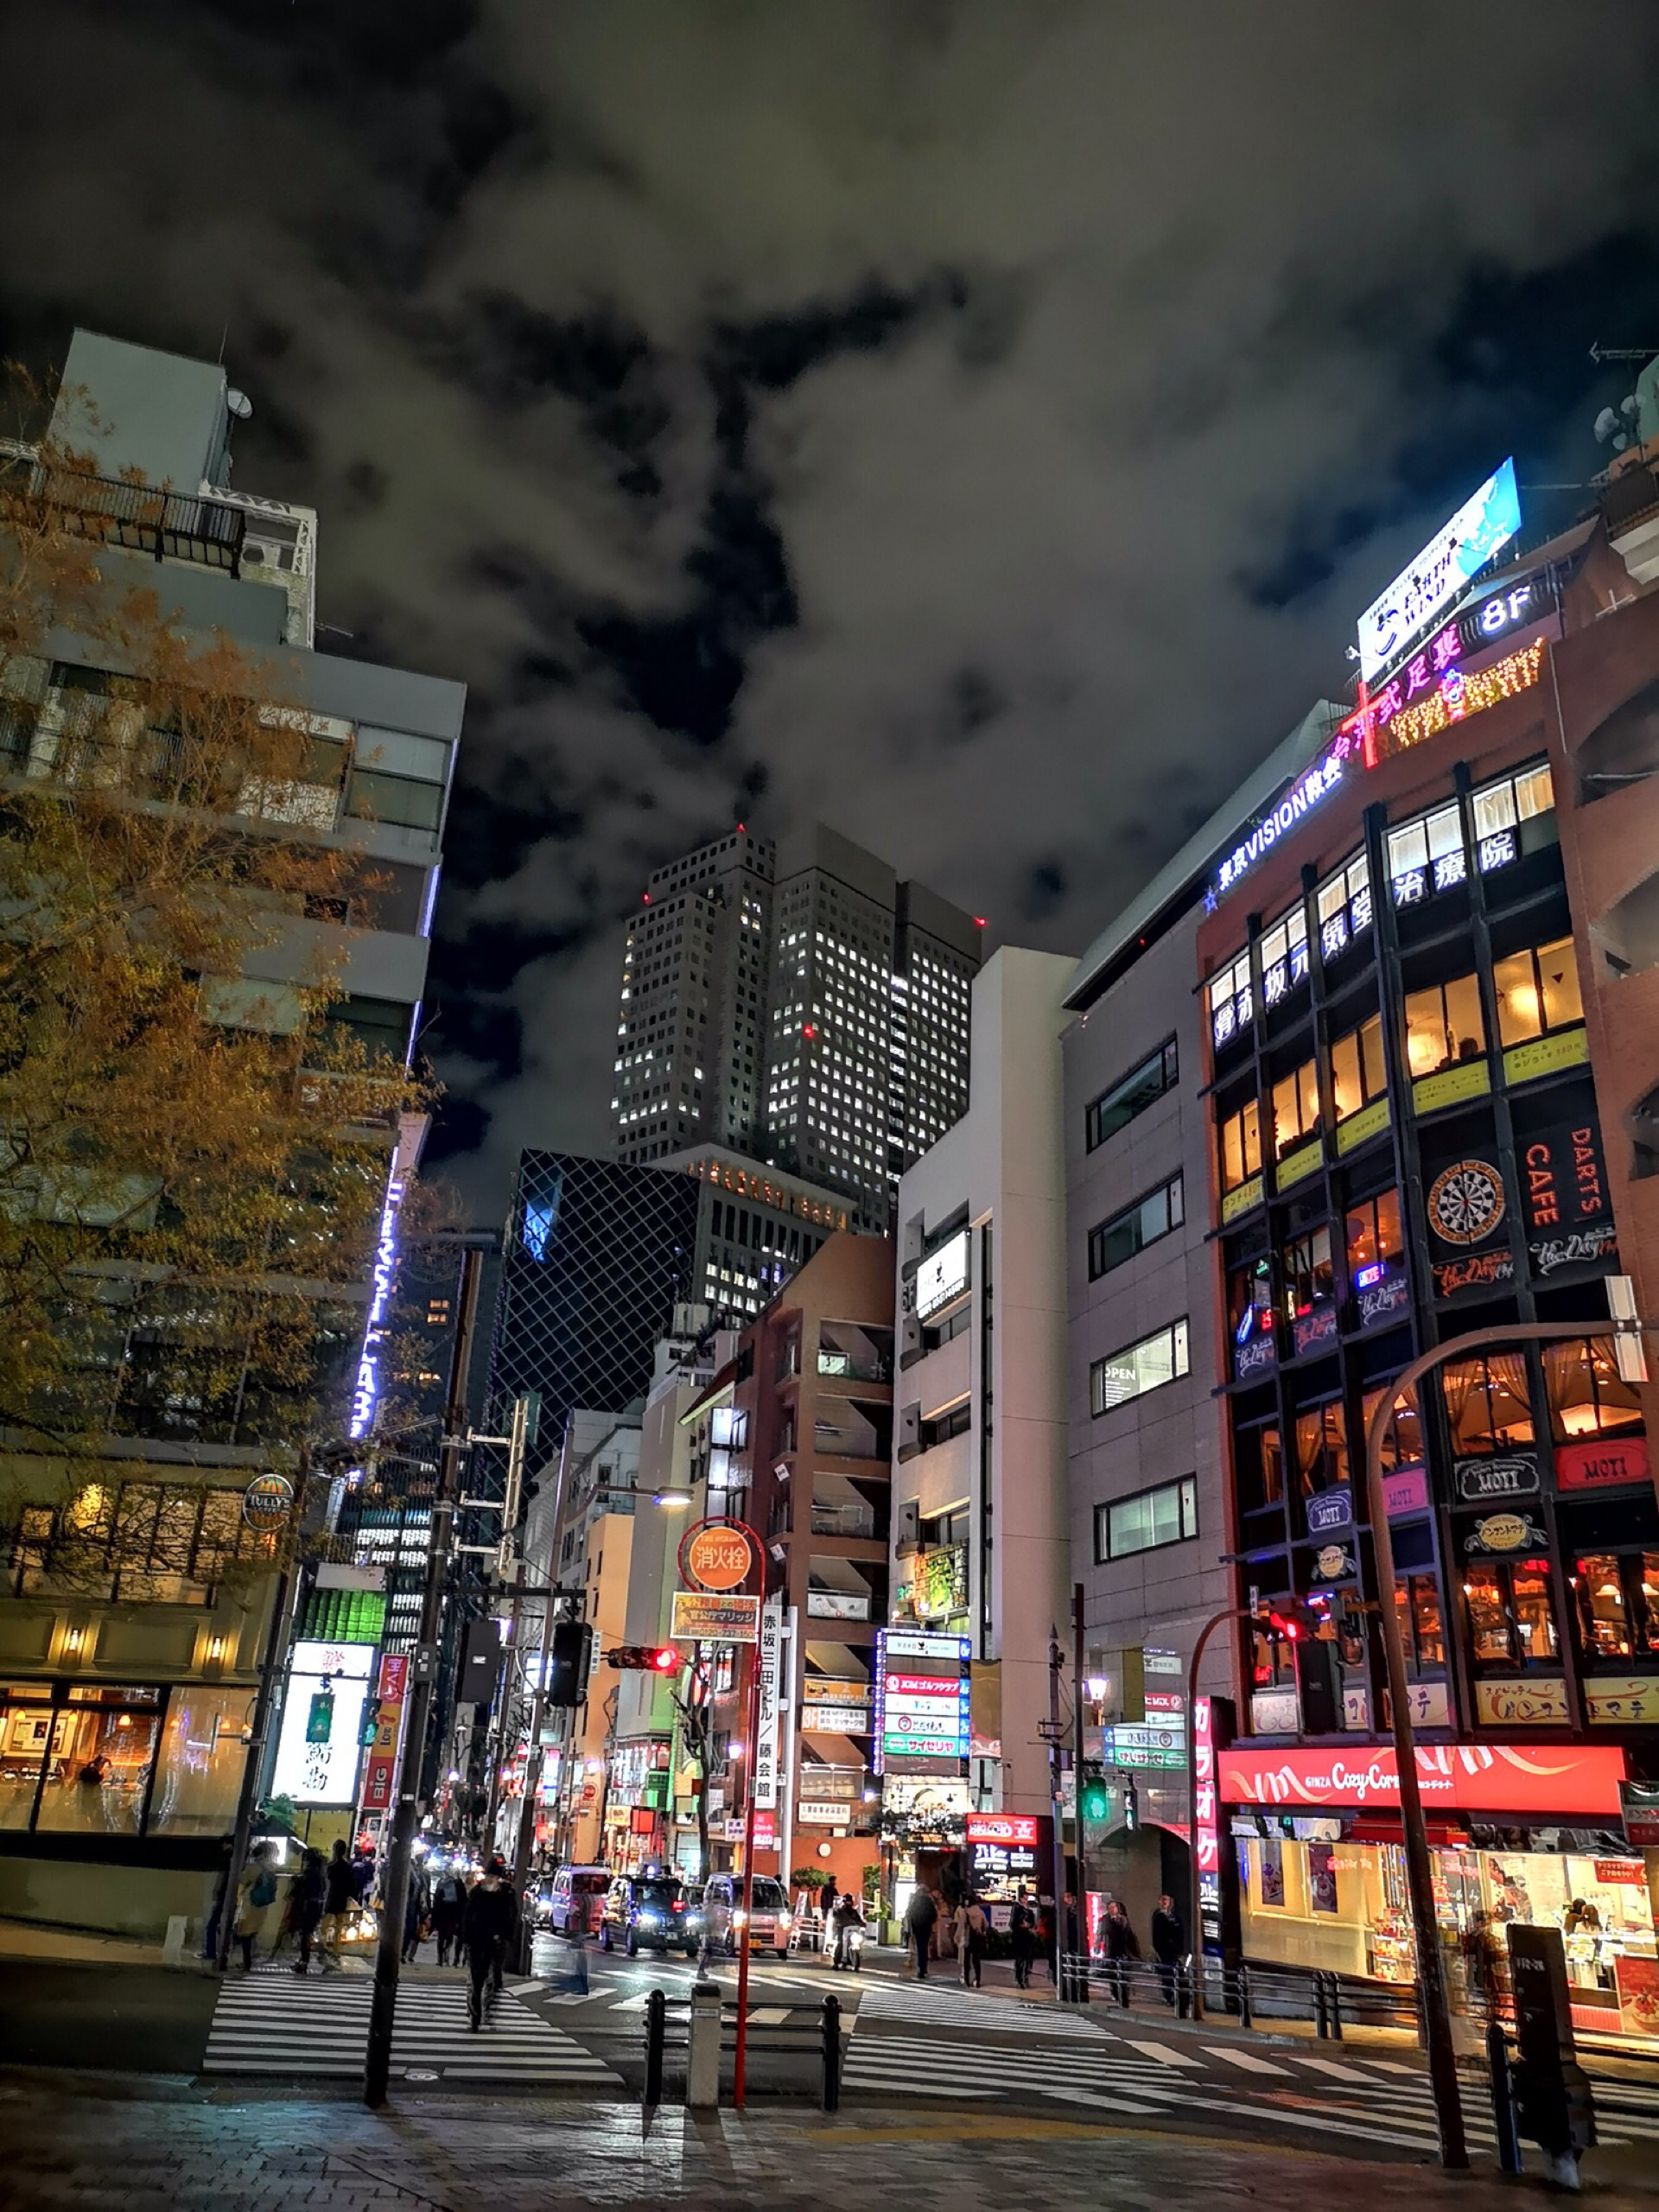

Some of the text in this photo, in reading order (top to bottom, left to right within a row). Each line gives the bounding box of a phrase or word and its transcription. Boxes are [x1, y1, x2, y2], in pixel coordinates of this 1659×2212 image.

[1483, 585, 1531, 633] 8F
[1571, 1127, 1603, 1215] DARTS
[1526, 1142, 1560, 1228] CAFE
[1104, 1366, 1136, 1381] OPEN
[1478, 1470, 1521, 1492] MOTI
[1583, 1455, 1628, 1481] MOTI
[696, 1546, 746, 1570] 消火栓
[804, 1707, 818, 1729] 3F
[372, 1767, 388, 1800] BIG
[1194, 1701, 1218, 1866] カラオケ
[1305, 1776, 1332, 1789] GINZA
